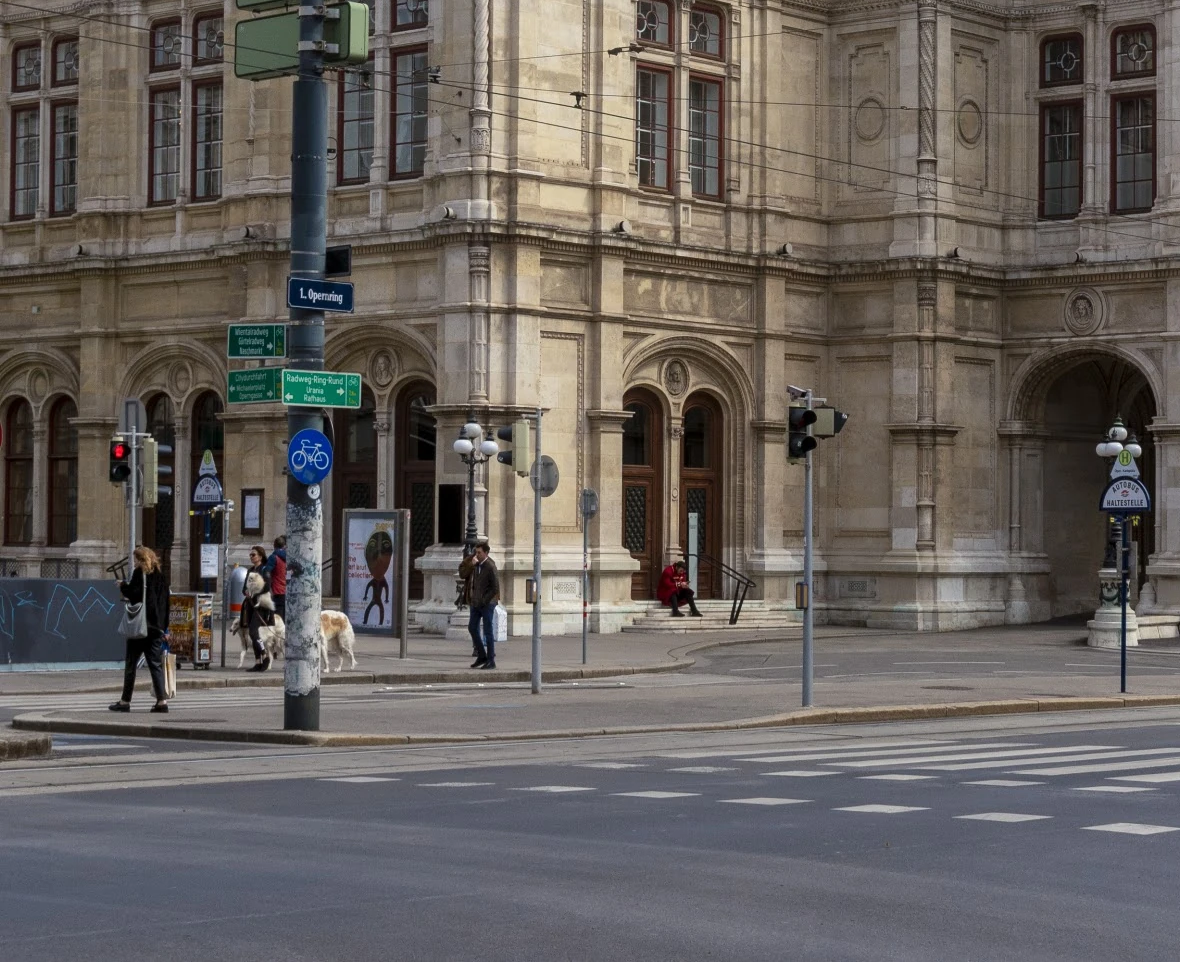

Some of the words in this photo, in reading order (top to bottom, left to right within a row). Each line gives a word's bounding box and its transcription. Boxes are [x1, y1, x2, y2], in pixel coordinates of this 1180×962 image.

[307, 288, 343, 305] Opernring
[286, 373, 344, 388] Radweg-Ring-Rund
[306, 386, 324, 395] Urania
[1121, 452, 1129, 463] H
[1112, 481, 1140, 494] AUTOBUS
